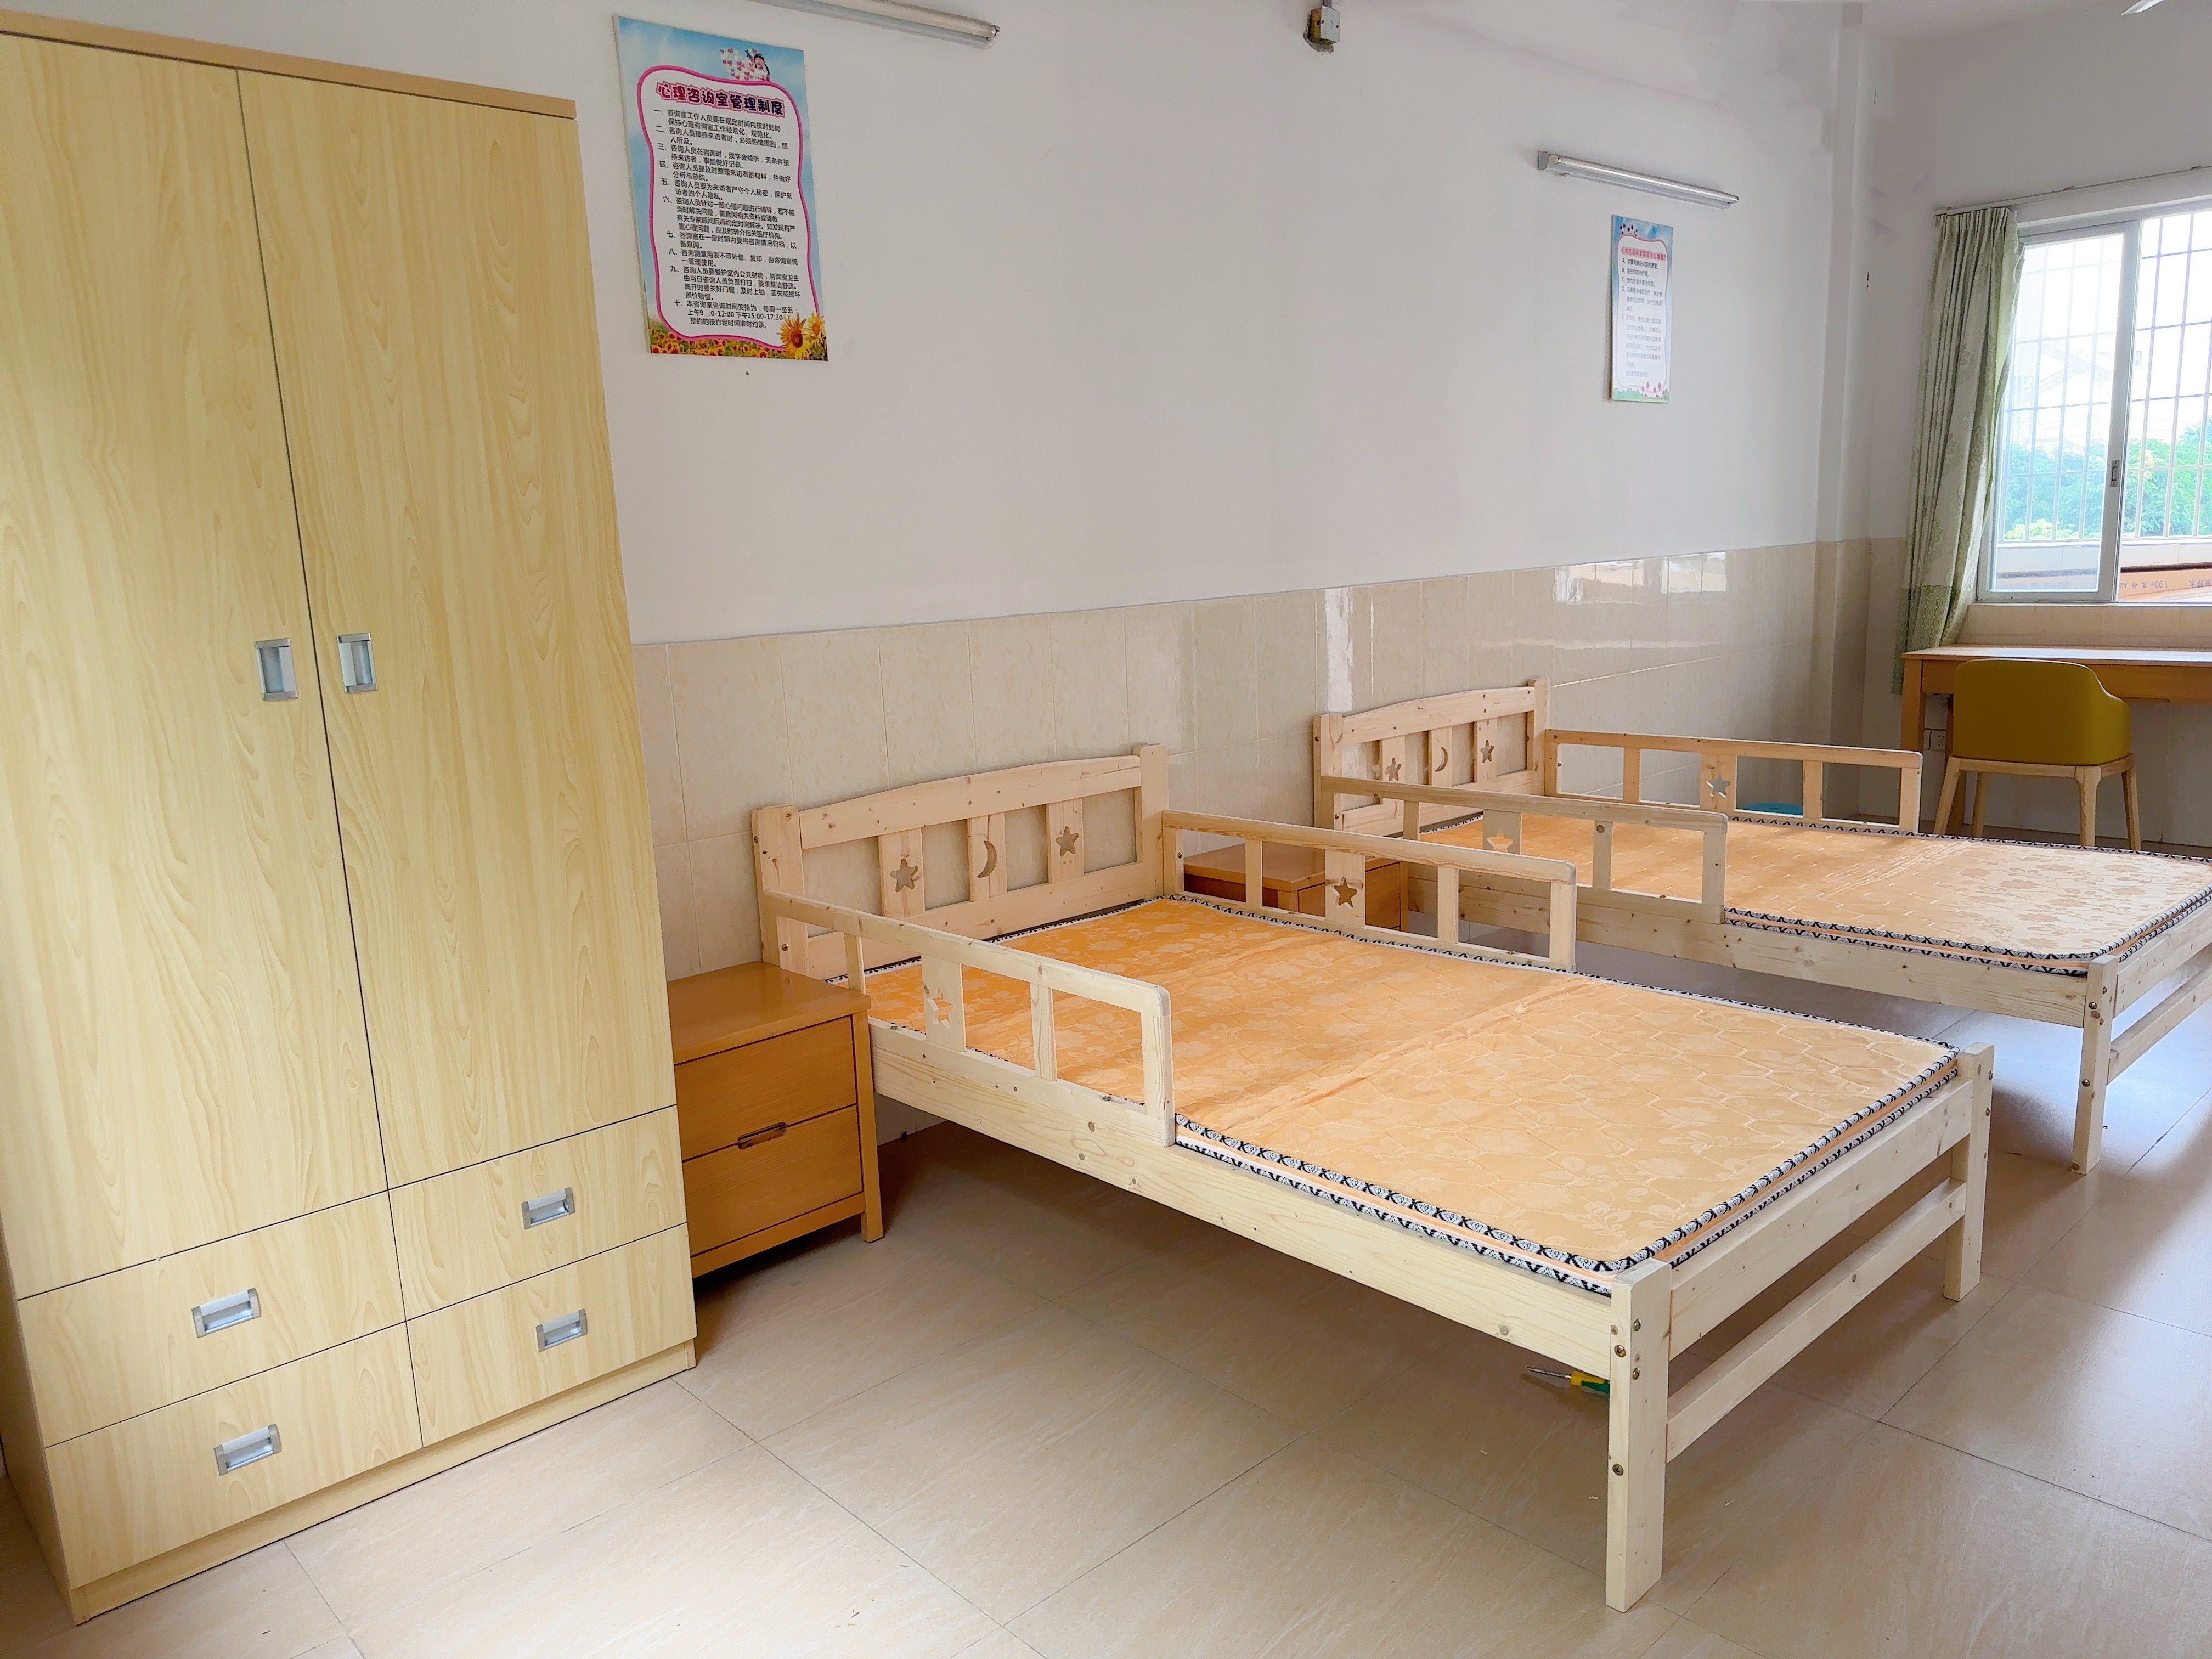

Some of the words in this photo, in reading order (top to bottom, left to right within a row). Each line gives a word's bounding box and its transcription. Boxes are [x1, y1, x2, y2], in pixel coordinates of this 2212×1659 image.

[657, 82, 785, 116] 心理咨询室管理制度
